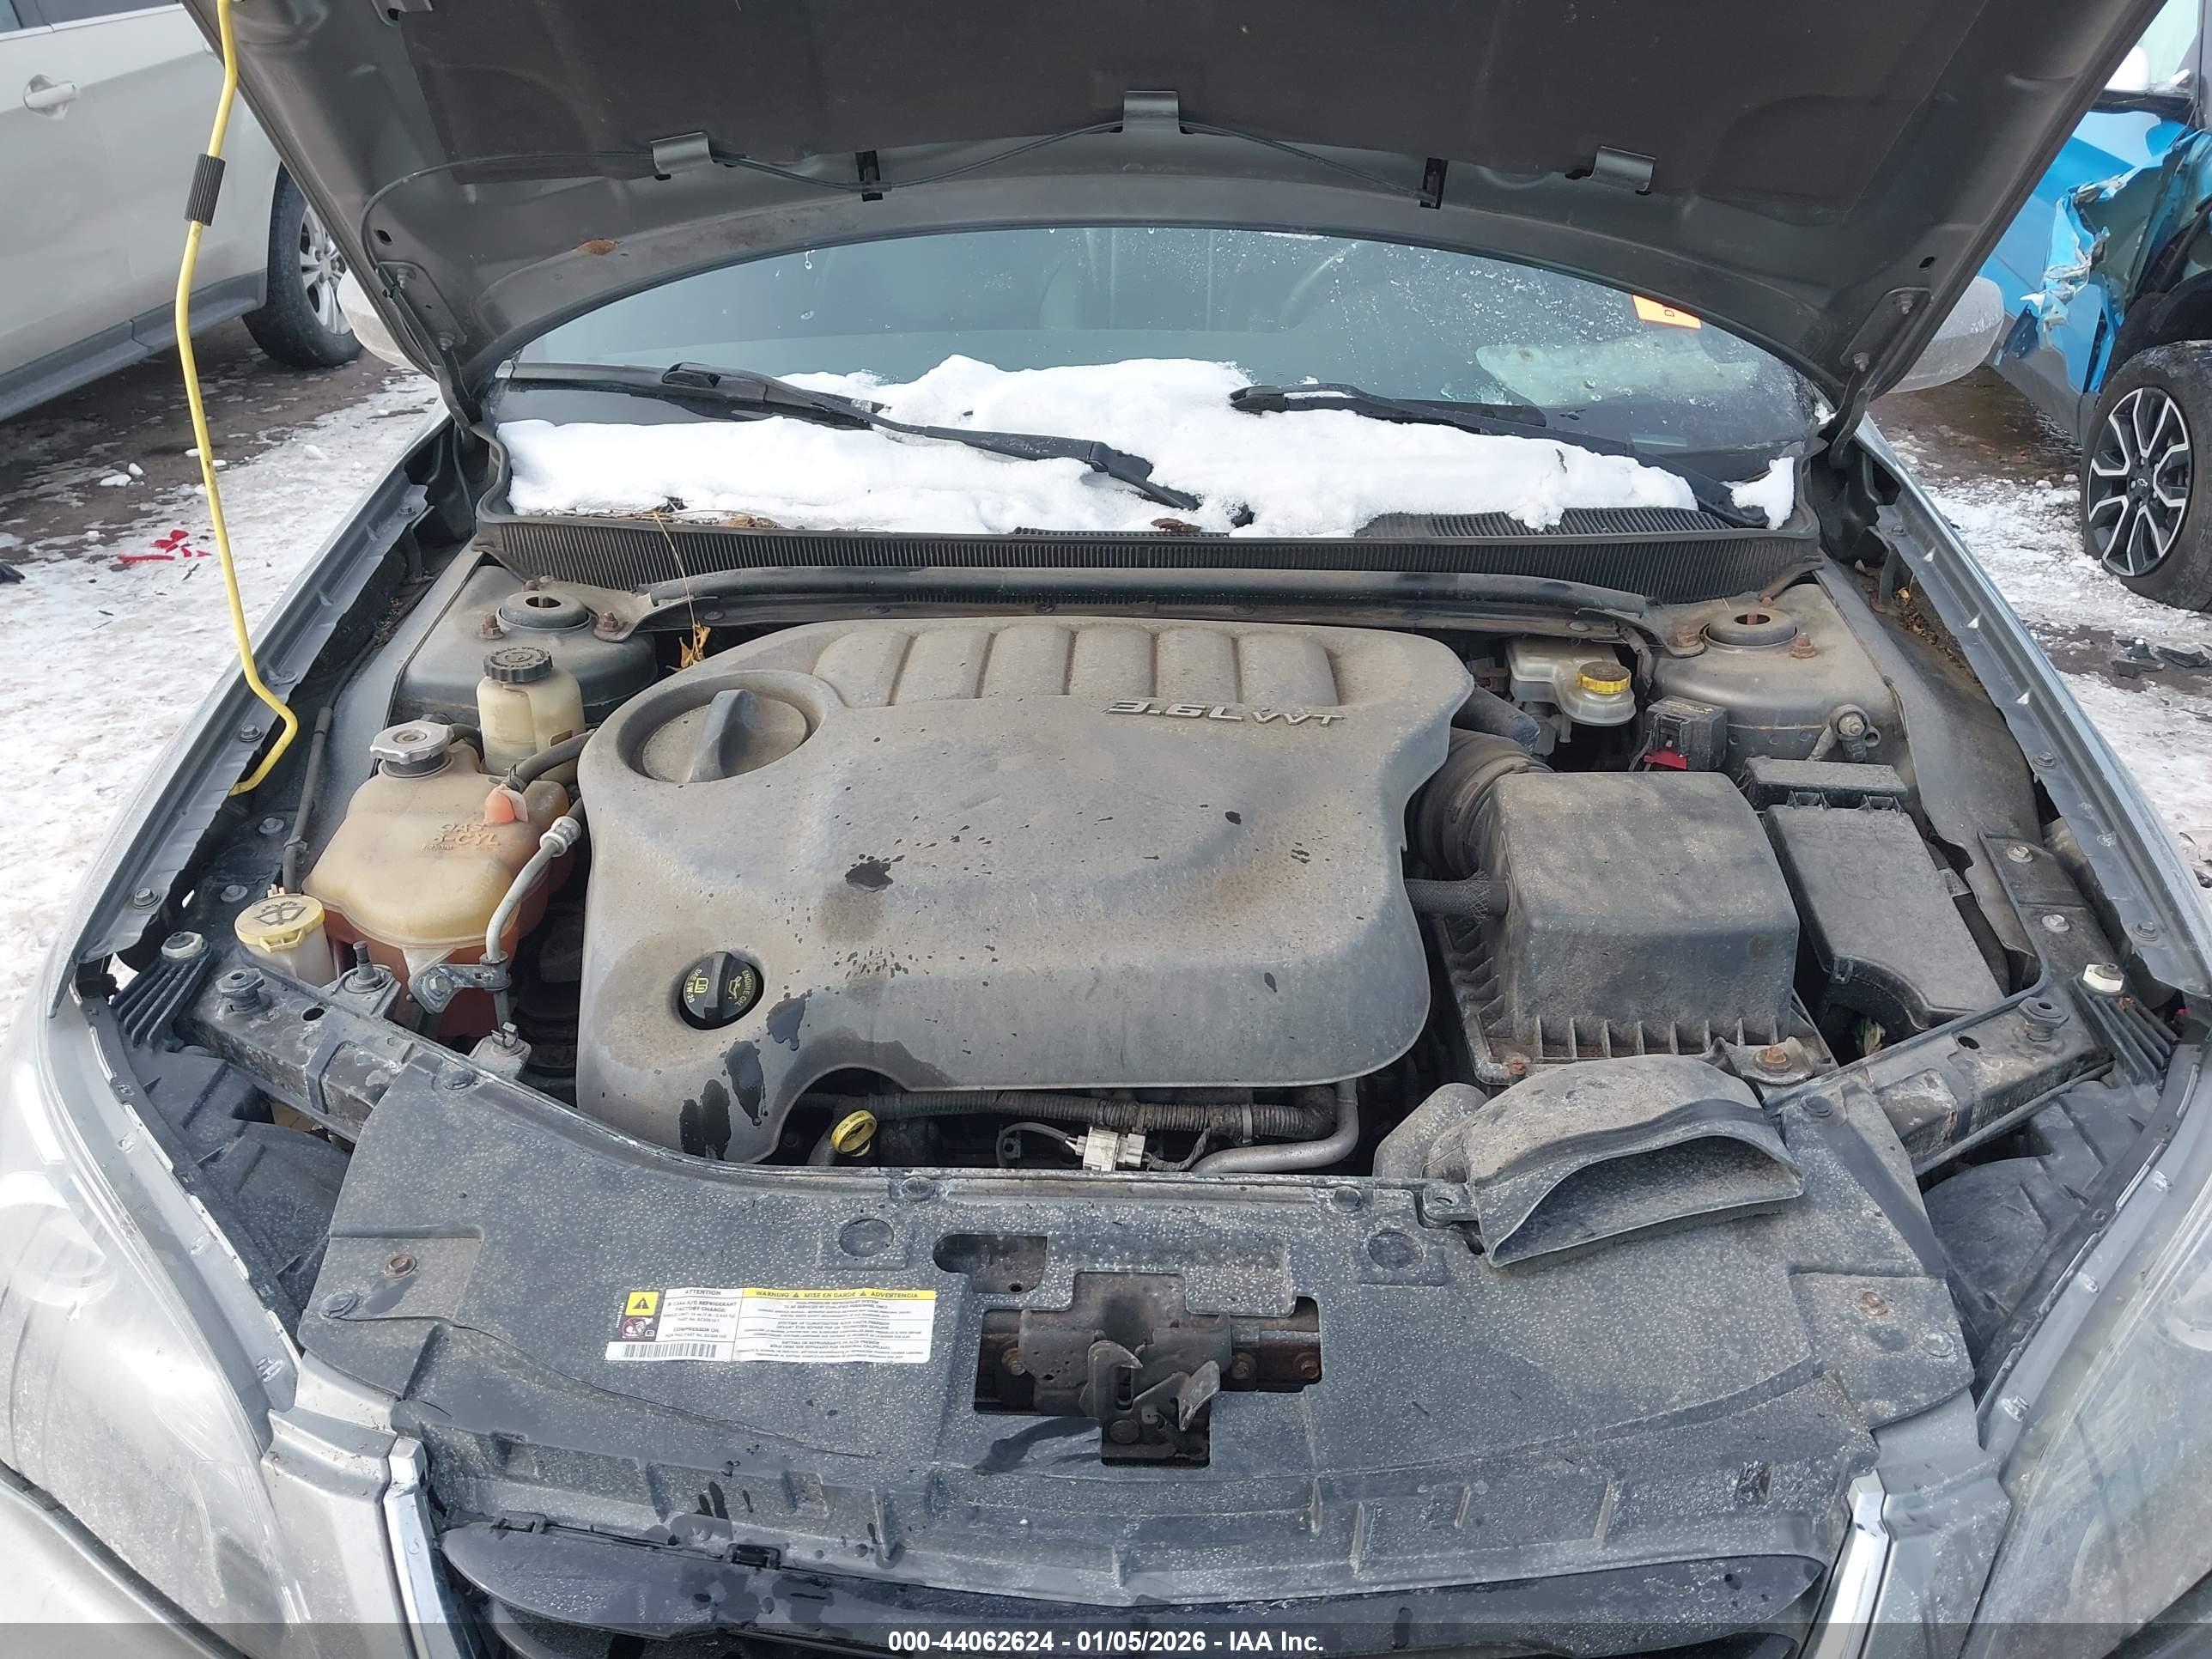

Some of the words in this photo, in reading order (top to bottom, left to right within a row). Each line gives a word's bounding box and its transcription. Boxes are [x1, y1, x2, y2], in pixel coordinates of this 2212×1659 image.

[1104, 700, 1244, 723] 3.6L
[1251, 709, 1345, 727] VVT
[690, 968, 703, 981] SAE
[741, 969, 753, 996] ENGINE
[734, 996, 747, 1006] OIL
